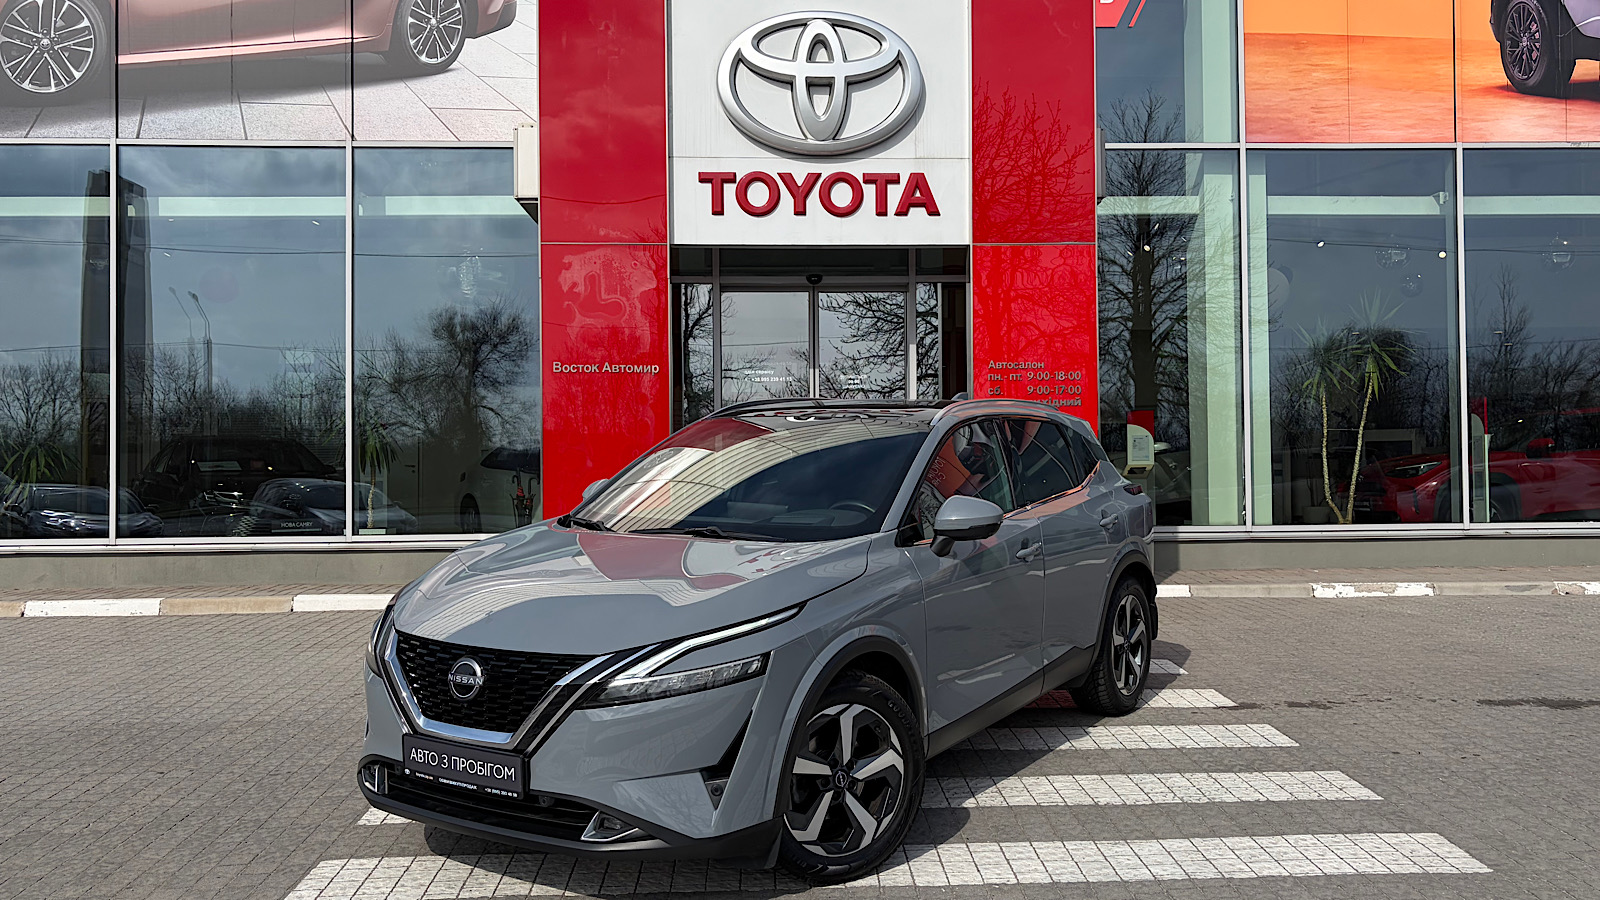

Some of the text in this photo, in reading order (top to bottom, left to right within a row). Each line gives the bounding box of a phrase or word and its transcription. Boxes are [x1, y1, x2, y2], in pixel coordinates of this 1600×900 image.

[698, 171, 940, 217] TOYOTA
[553, 362, 659, 375] Восток Автомир
[988, 360, 1044, 369] Автосалон
[988, 385, 1081, 395] сб. 9:00-17:00
[448, 673, 484, 685] NISSAN
[410, 747, 438, 766] АВТО
[451, 756, 516, 781] ПРОБІГОМ
